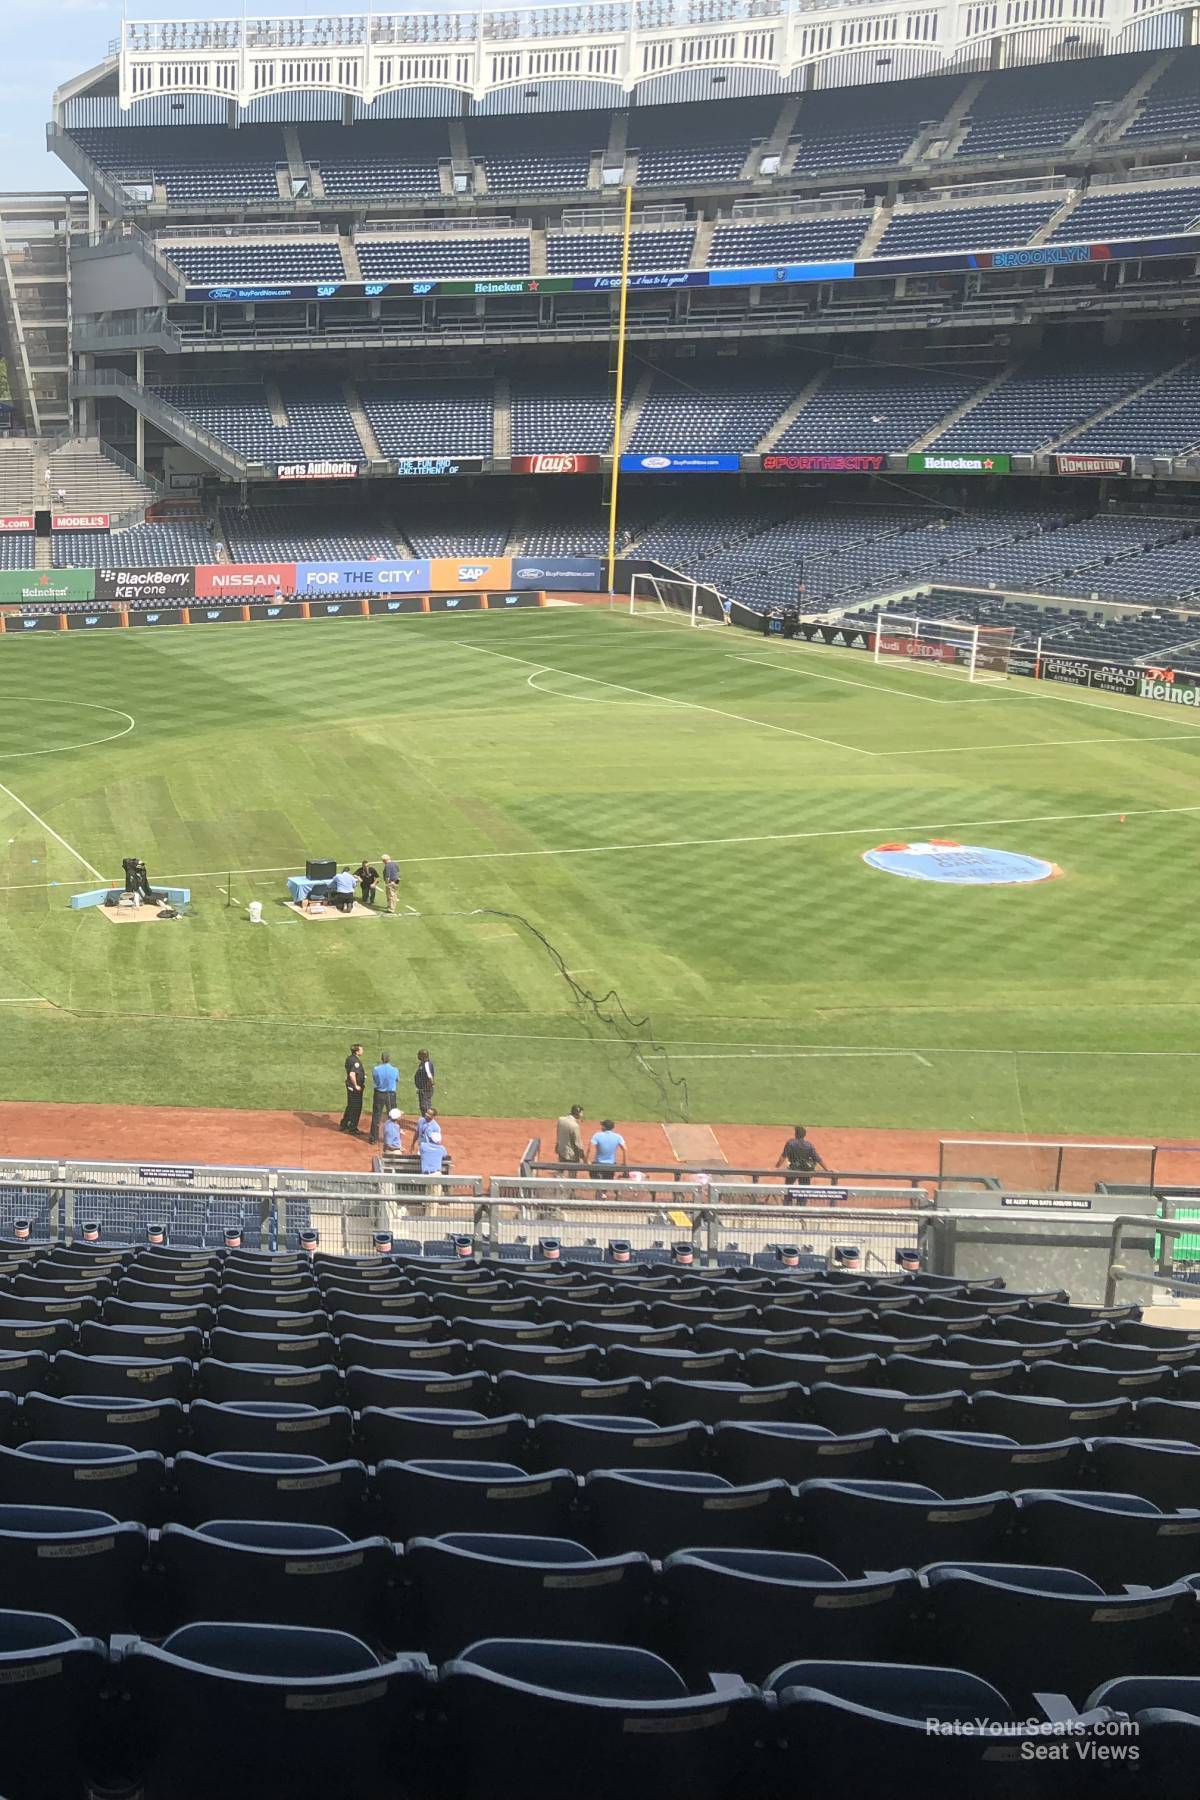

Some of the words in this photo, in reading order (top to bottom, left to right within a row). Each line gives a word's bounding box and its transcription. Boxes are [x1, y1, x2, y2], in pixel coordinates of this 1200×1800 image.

[992, 247, 1090, 266] BROOKLYN
[317, 286, 336, 296] SAP
[365, 285, 383, 294] SAP
[413, 284, 431, 293] SAP
[475, 283, 524, 293] Heineken
[278, 464, 306, 475] Parts
[307, 461, 357, 474] Authority
[400, 460, 414, 468] THE
[763, 455, 881, 470] #FORTHECITY
[924, 458, 982, 469] Heineken
[1059, 456, 1123, 471] ADMIRATION
[398, 466, 446, 474] EXCITEMENT
[57, 517, 103, 526] MODELL'S
[307, 572, 338, 584] FOR
[344, 571, 373, 583] THE
[378, 570, 413, 583] CITY
[458, 568, 482, 580] SAP
[212, 575, 280, 586] NISSAN
[22, 587, 68, 597] Heineken
[878, 641, 899, 650] Audi
[1048, 663, 1087, 678] ETIHAD
[1093, 673, 1135, 687] ETIHAD
